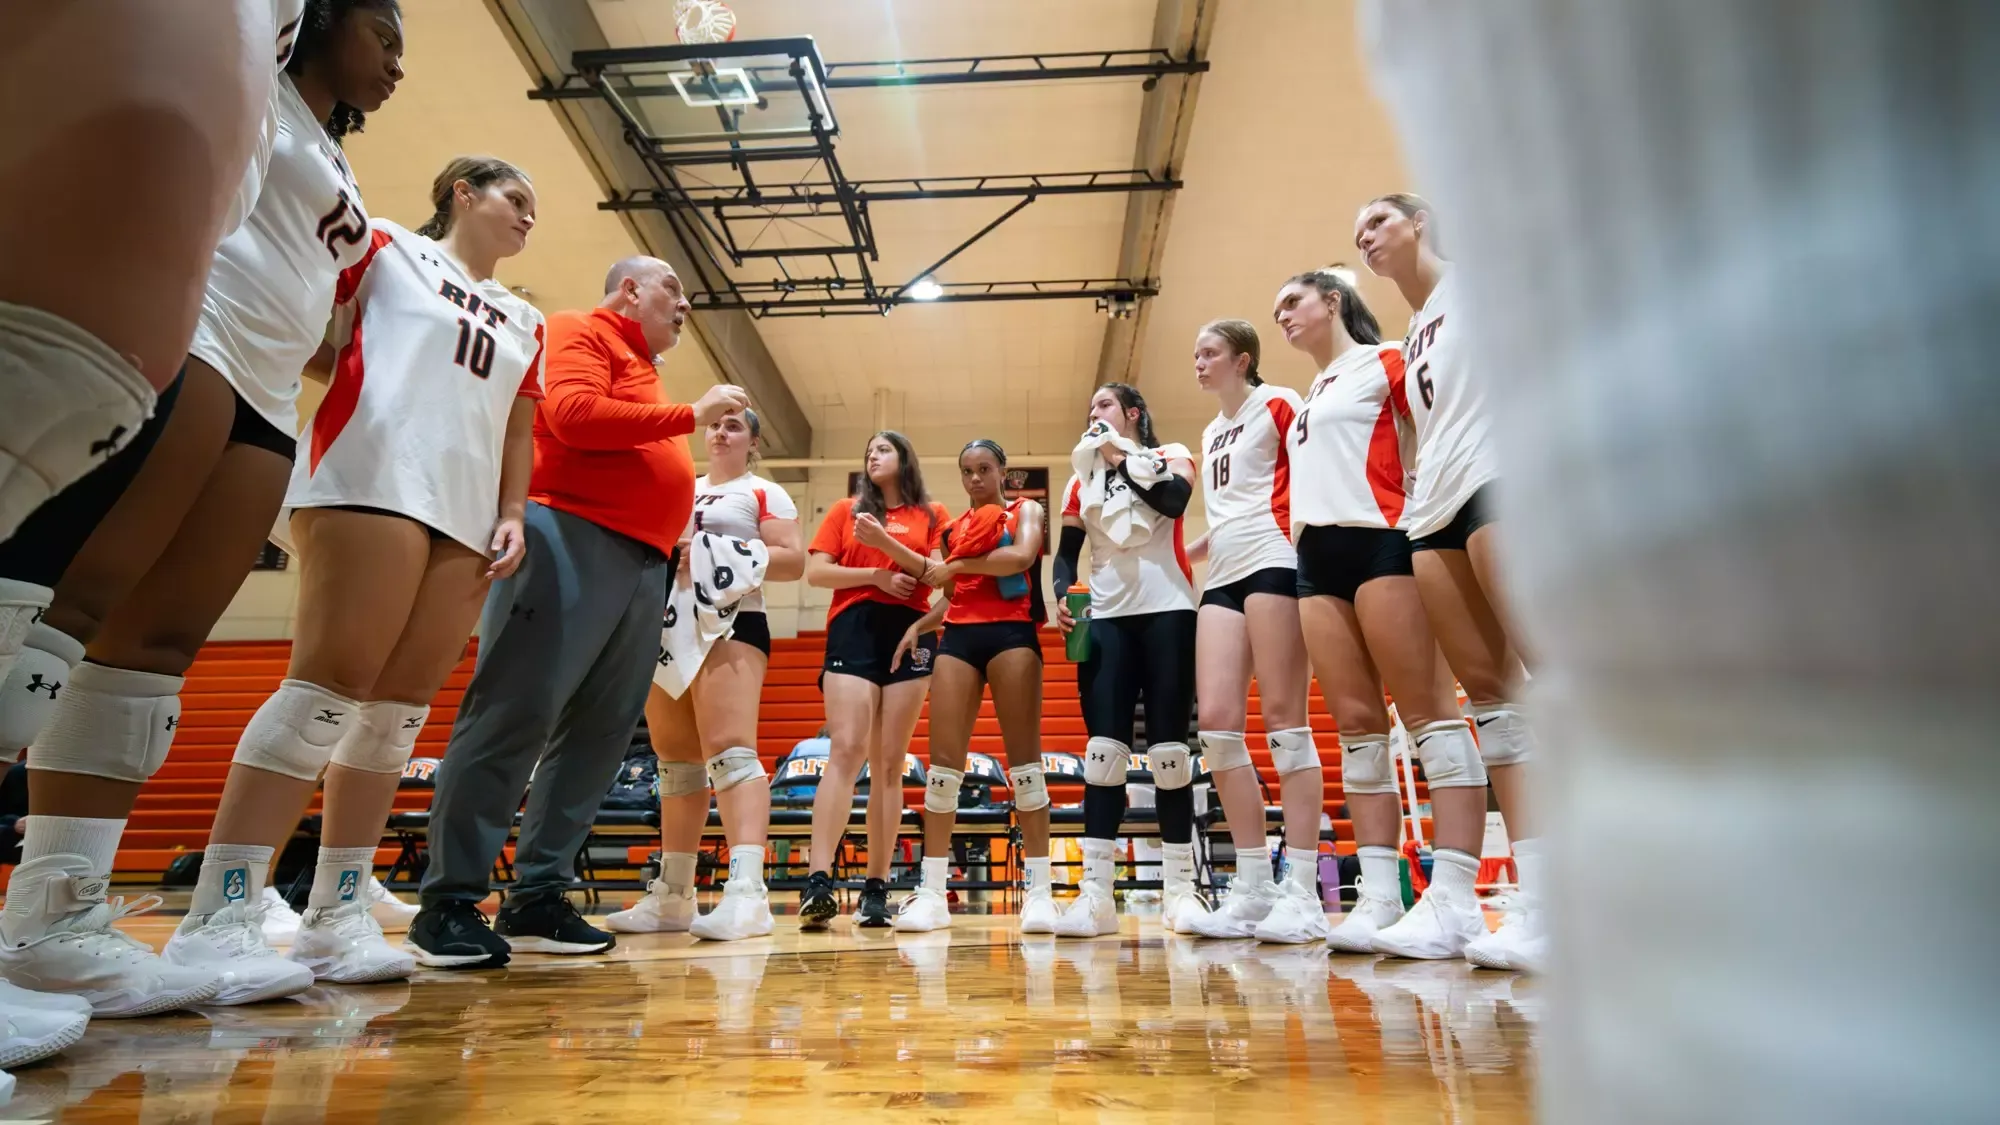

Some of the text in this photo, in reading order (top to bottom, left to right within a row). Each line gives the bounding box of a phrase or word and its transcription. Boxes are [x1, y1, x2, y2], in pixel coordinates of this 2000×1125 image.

[315, 187, 367, 262] 12
[438, 278, 508, 331] RIT
[453, 316, 497, 380] 10
[1406, 313, 1446, 370] RIT
[1417, 360, 1435, 411] 6
[1208, 423, 1245, 455] RIT
[1296, 408, 1310, 446] 9
[1211, 453, 1230, 491] 18
[695, 494, 725, 506] IT
[965, 758, 993, 776] IT
[1041, 757, 1078, 775] IT
